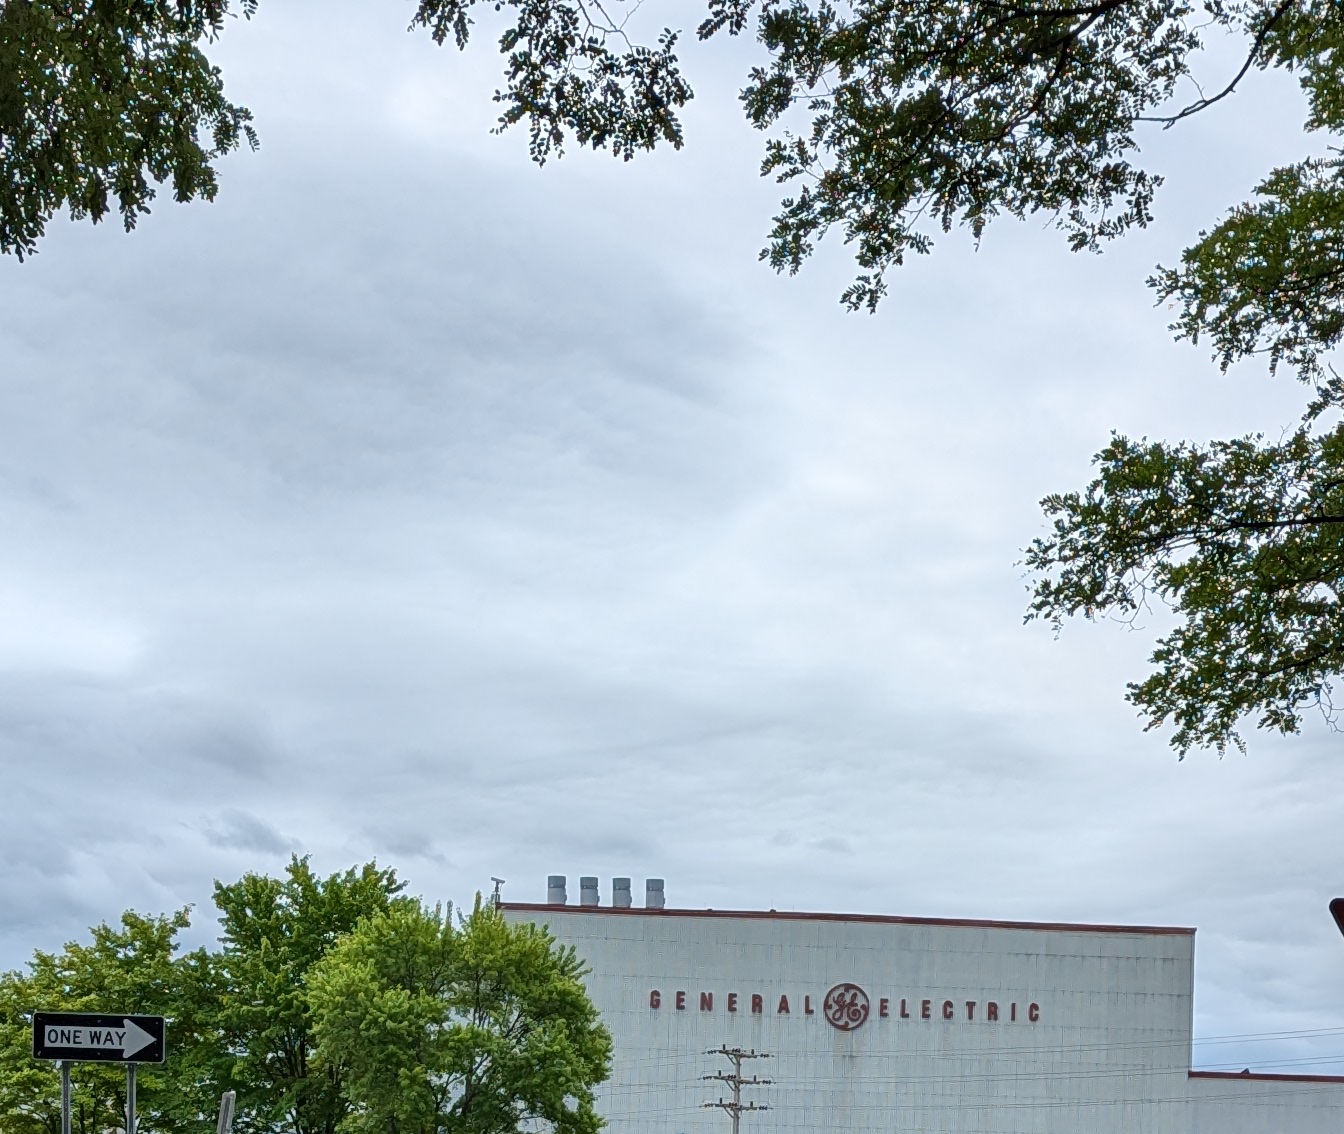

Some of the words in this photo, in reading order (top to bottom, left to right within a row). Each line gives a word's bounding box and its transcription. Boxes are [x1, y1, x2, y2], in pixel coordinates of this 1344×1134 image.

[650, 990, 814, 1014] GENERAL
[879, 998, 1040, 1022] ELECTRIC
[47, 1028, 83, 1045] ONE
[89, 1030, 127, 1046] WAY
